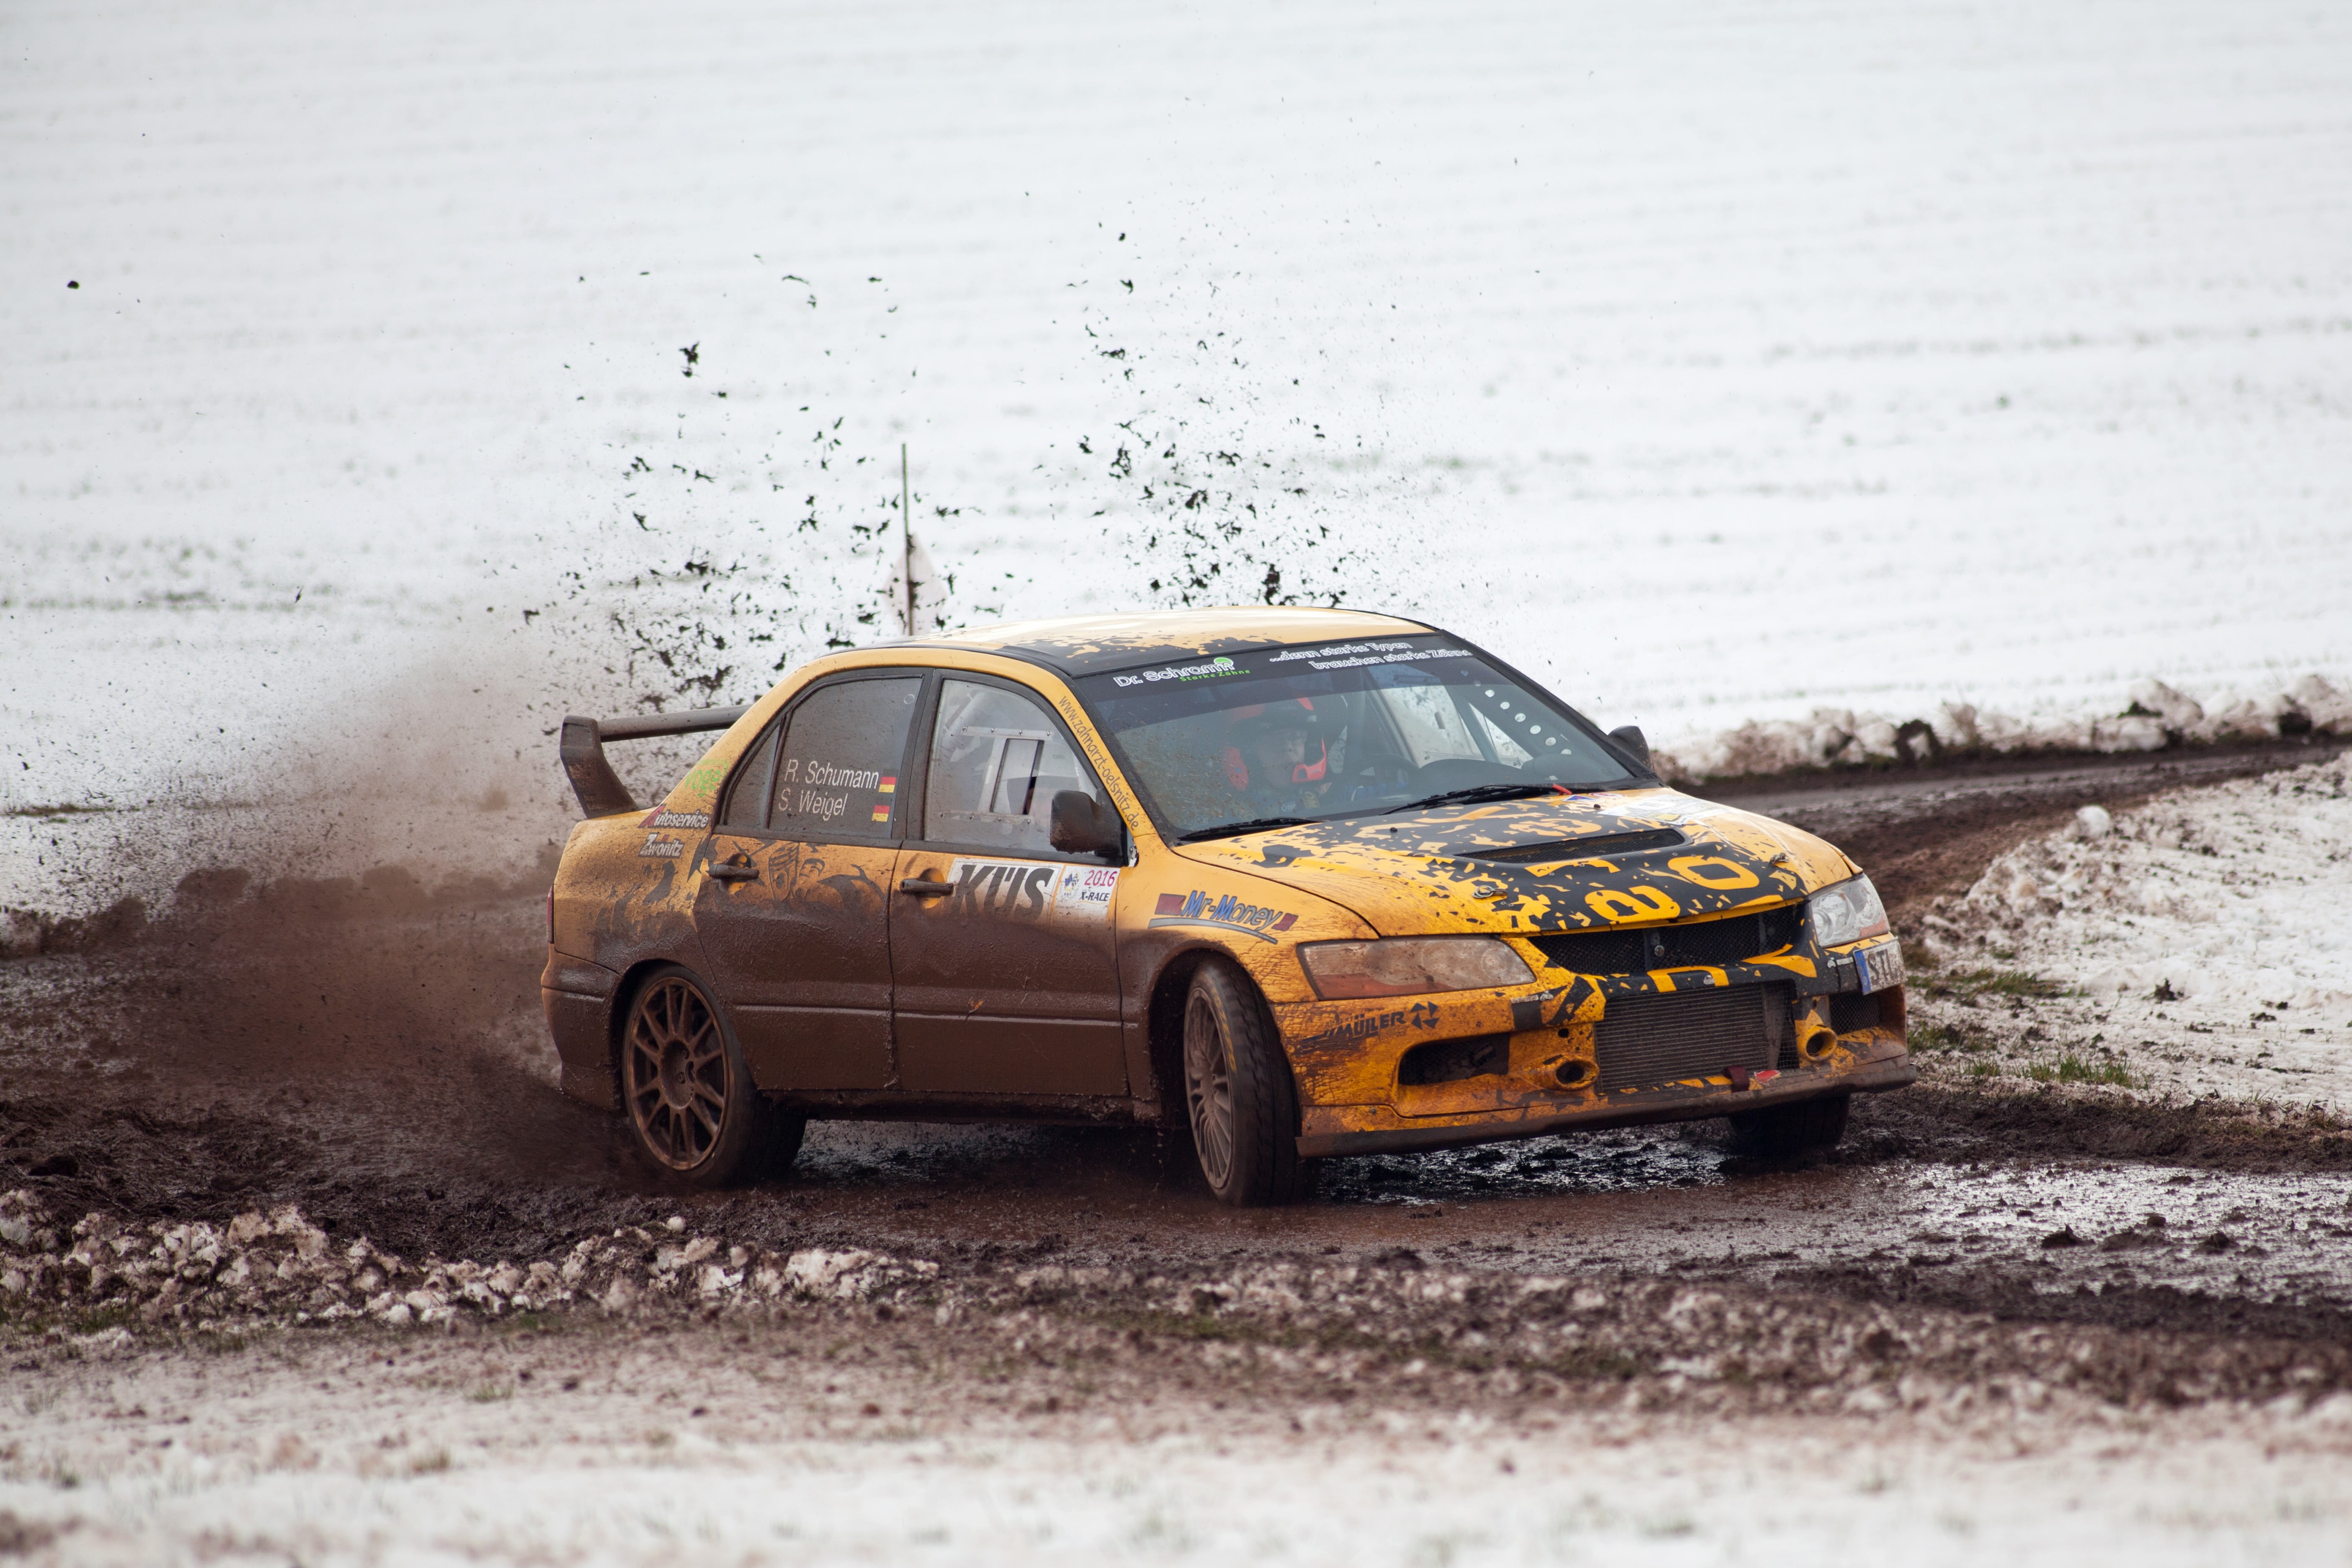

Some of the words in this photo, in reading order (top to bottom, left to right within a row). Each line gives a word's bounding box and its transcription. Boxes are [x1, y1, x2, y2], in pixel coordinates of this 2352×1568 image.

[1269, 651, 1321, 662] ...denn
[1320, 645, 1369, 656] starke
[1364, 642, 1413, 652] Typen
[1308, 656, 1385, 670] brauchen
[1383, 651, 1431, 662] starke
[1425, 649, 1473, 658] Zähne
[1113, 676, 1144, 687] Dr.
[1179, 672, 1216, 682] Starke
[1218, 669, 1251, 677] Zähne
[784, 758, 799, 782] R.
[805, 761, 879, 789] Schumann
[1058, 696, 1139, 831] www.zahnarzt-oelsnitz.de
[778, 787, 791, 811] S.
[799, 789, 848, 821] Weigel
[637, 803, 711, 830] Autoservice
[1084, 869, 1118, 887] 2016
[950, 864, 1054, 921] KÜS
[1078, 891, 1111, 902] X-RACE
[1181, 890, 1283, 931] Mr-Money
